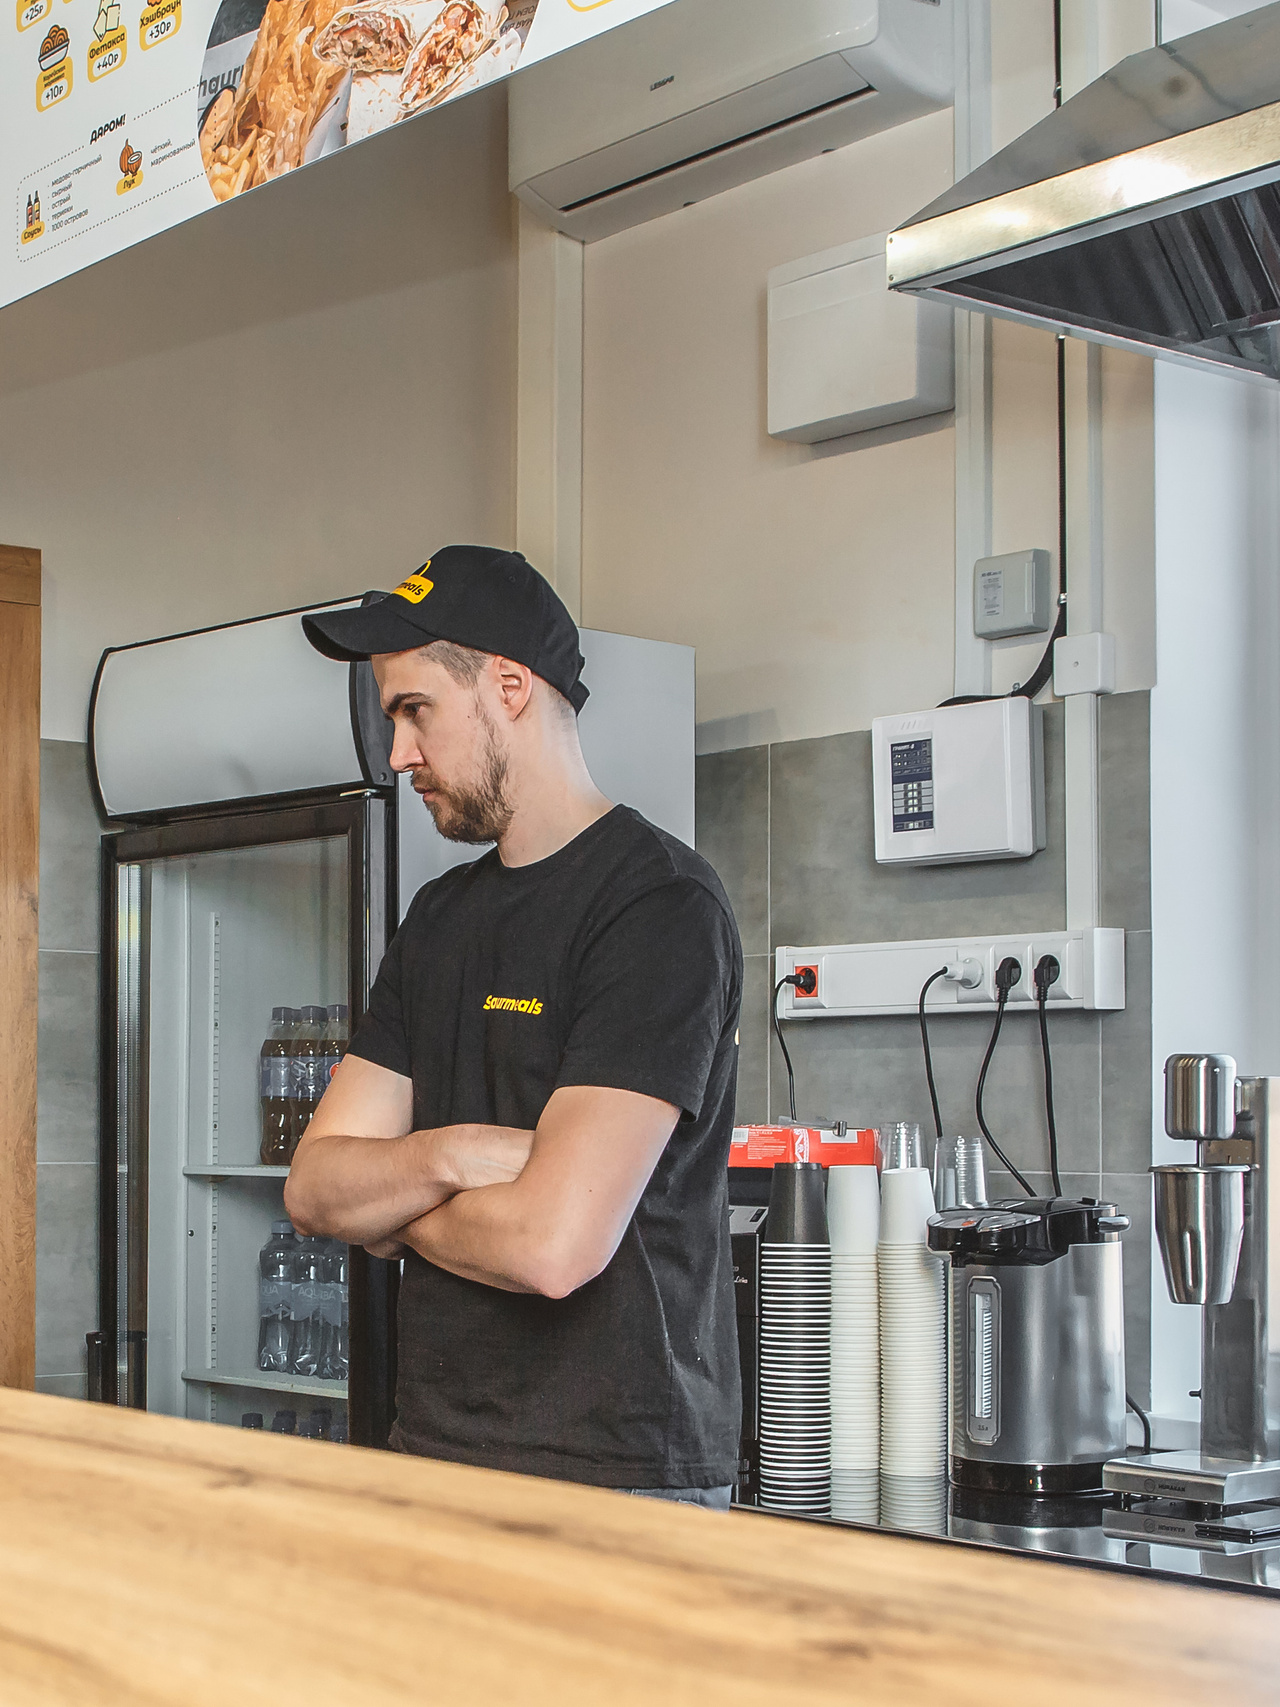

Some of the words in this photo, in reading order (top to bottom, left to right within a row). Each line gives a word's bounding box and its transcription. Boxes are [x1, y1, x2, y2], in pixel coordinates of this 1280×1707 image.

[89, 32, 126, 59] Фетакса
[89, 113, 126, 145] ДАРОМ!
[151, 138, 196, 167] маринованный
[23, 225, 42, 241] Соусы
